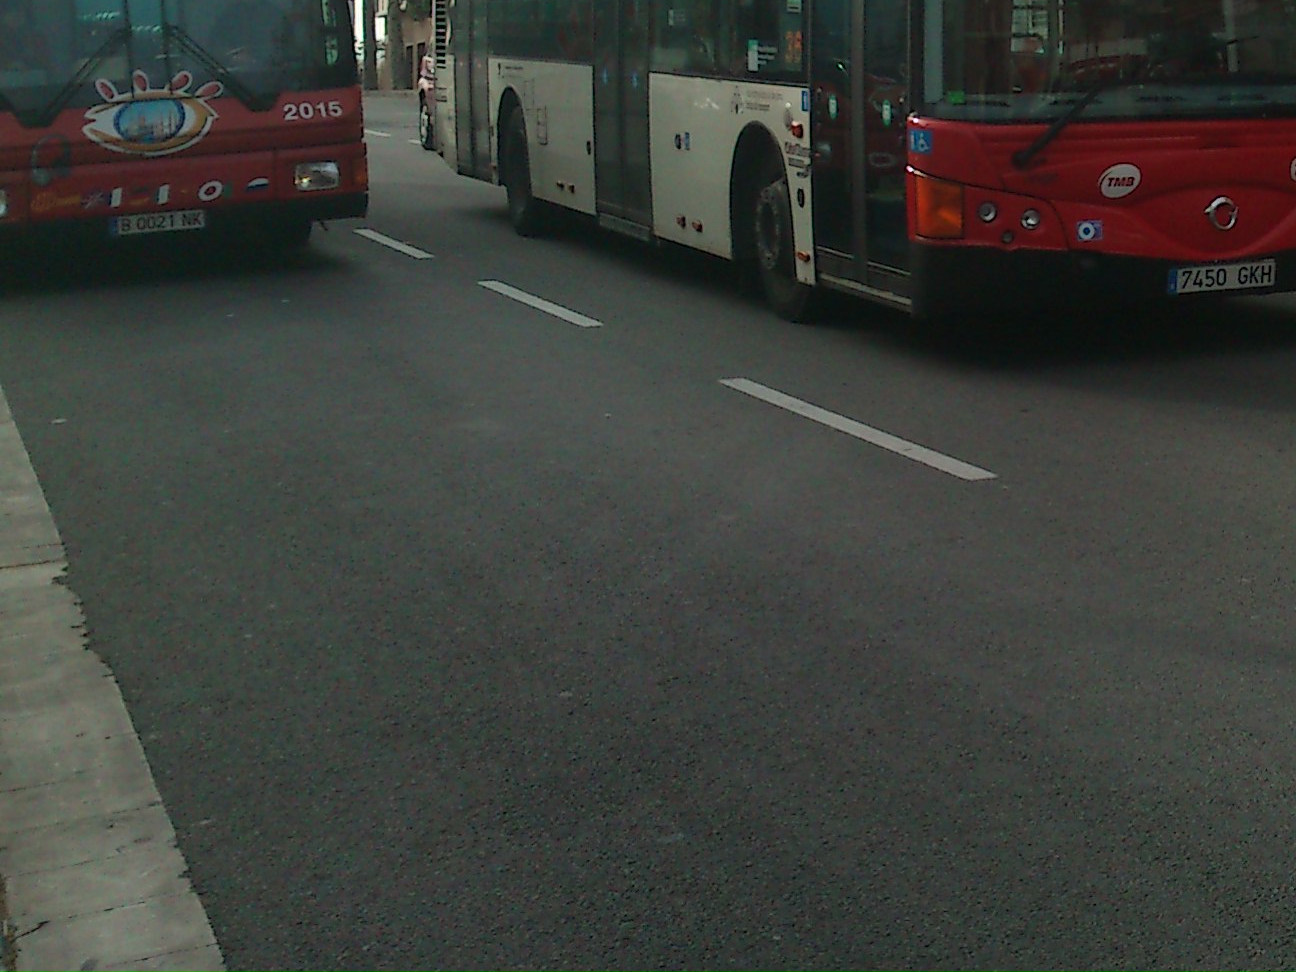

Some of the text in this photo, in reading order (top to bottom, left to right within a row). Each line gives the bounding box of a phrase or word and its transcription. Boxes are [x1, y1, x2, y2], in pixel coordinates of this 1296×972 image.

[282, 100, 343, 122] 2015
[1107, 176, 1136, 188] TMB
[121, 217, 131, 233] B
[136, 213, 175, 231] 0021
[1180, 264, 1273, 290] 7450 GKH
